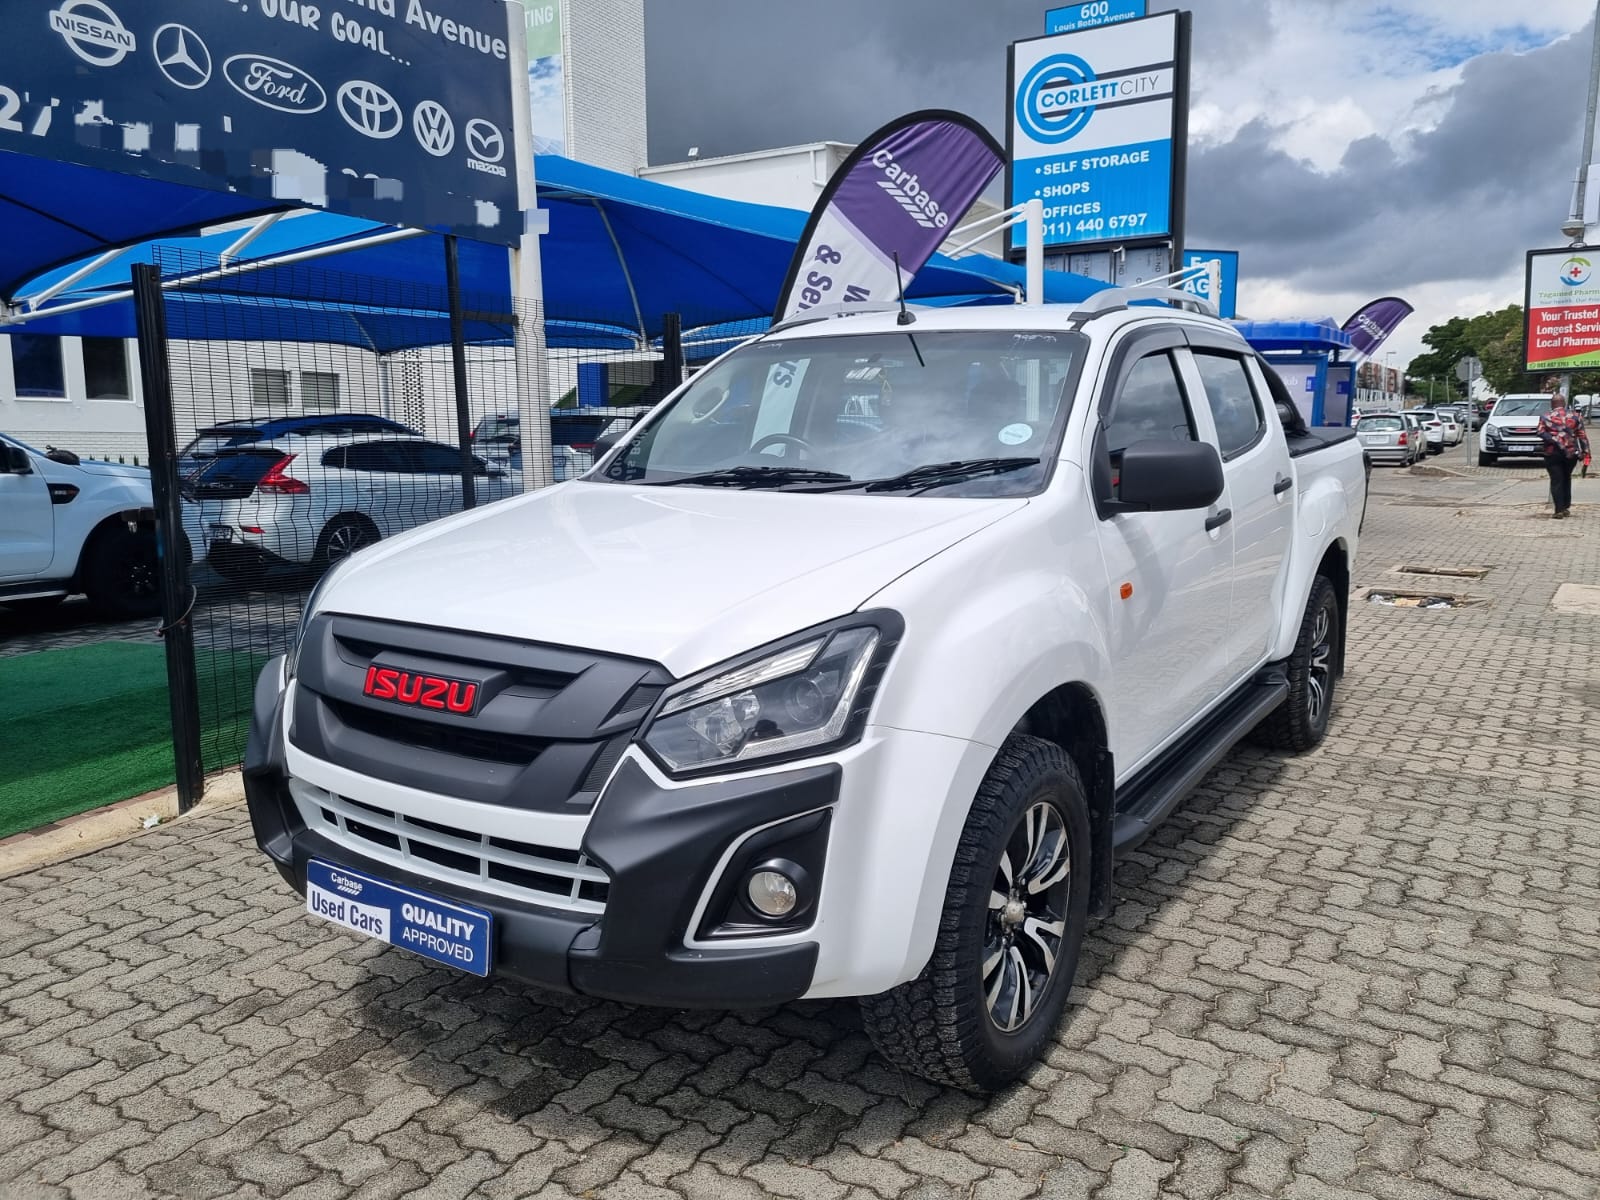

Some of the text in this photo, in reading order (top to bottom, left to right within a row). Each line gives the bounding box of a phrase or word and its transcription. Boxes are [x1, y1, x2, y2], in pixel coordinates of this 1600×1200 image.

[1080, 1, 1109, 19] 600
[55, 15, 131, 47] NISSAN
[405, 0, 507, 59] Avenue
[1054, 11, 1136, 33] Louis Botha Avenue
[244, 62, 308, 104] Ford
[467, 158, 507, 177] mazda
[1043, 151, 1150, 176] SELF STORAGE
[872, 149, 949, 228] Carbase
[1043, 182, 1090, 198] SHOPS
[1042, 202, 1101, 219] OFFICES
[1075, 218, 1104, 232] 440
[1108, 213, 1148, 229] 6797
[1184, 279, 1222, 294] AG
[1541, 309, 1599, 321] Your Trusted
[1536, 322, 1600, 336] Longest Servi
[1536, 337, 1561, 348] Local
[365, 666, 476, 713] ISUZU
[331, 872, 363, 891] Carbase
[312, 890, 383, 935] Used Cars
[401, 902, 475, 941] QUALITY
[402, 926, 474, 962] APPROVED
